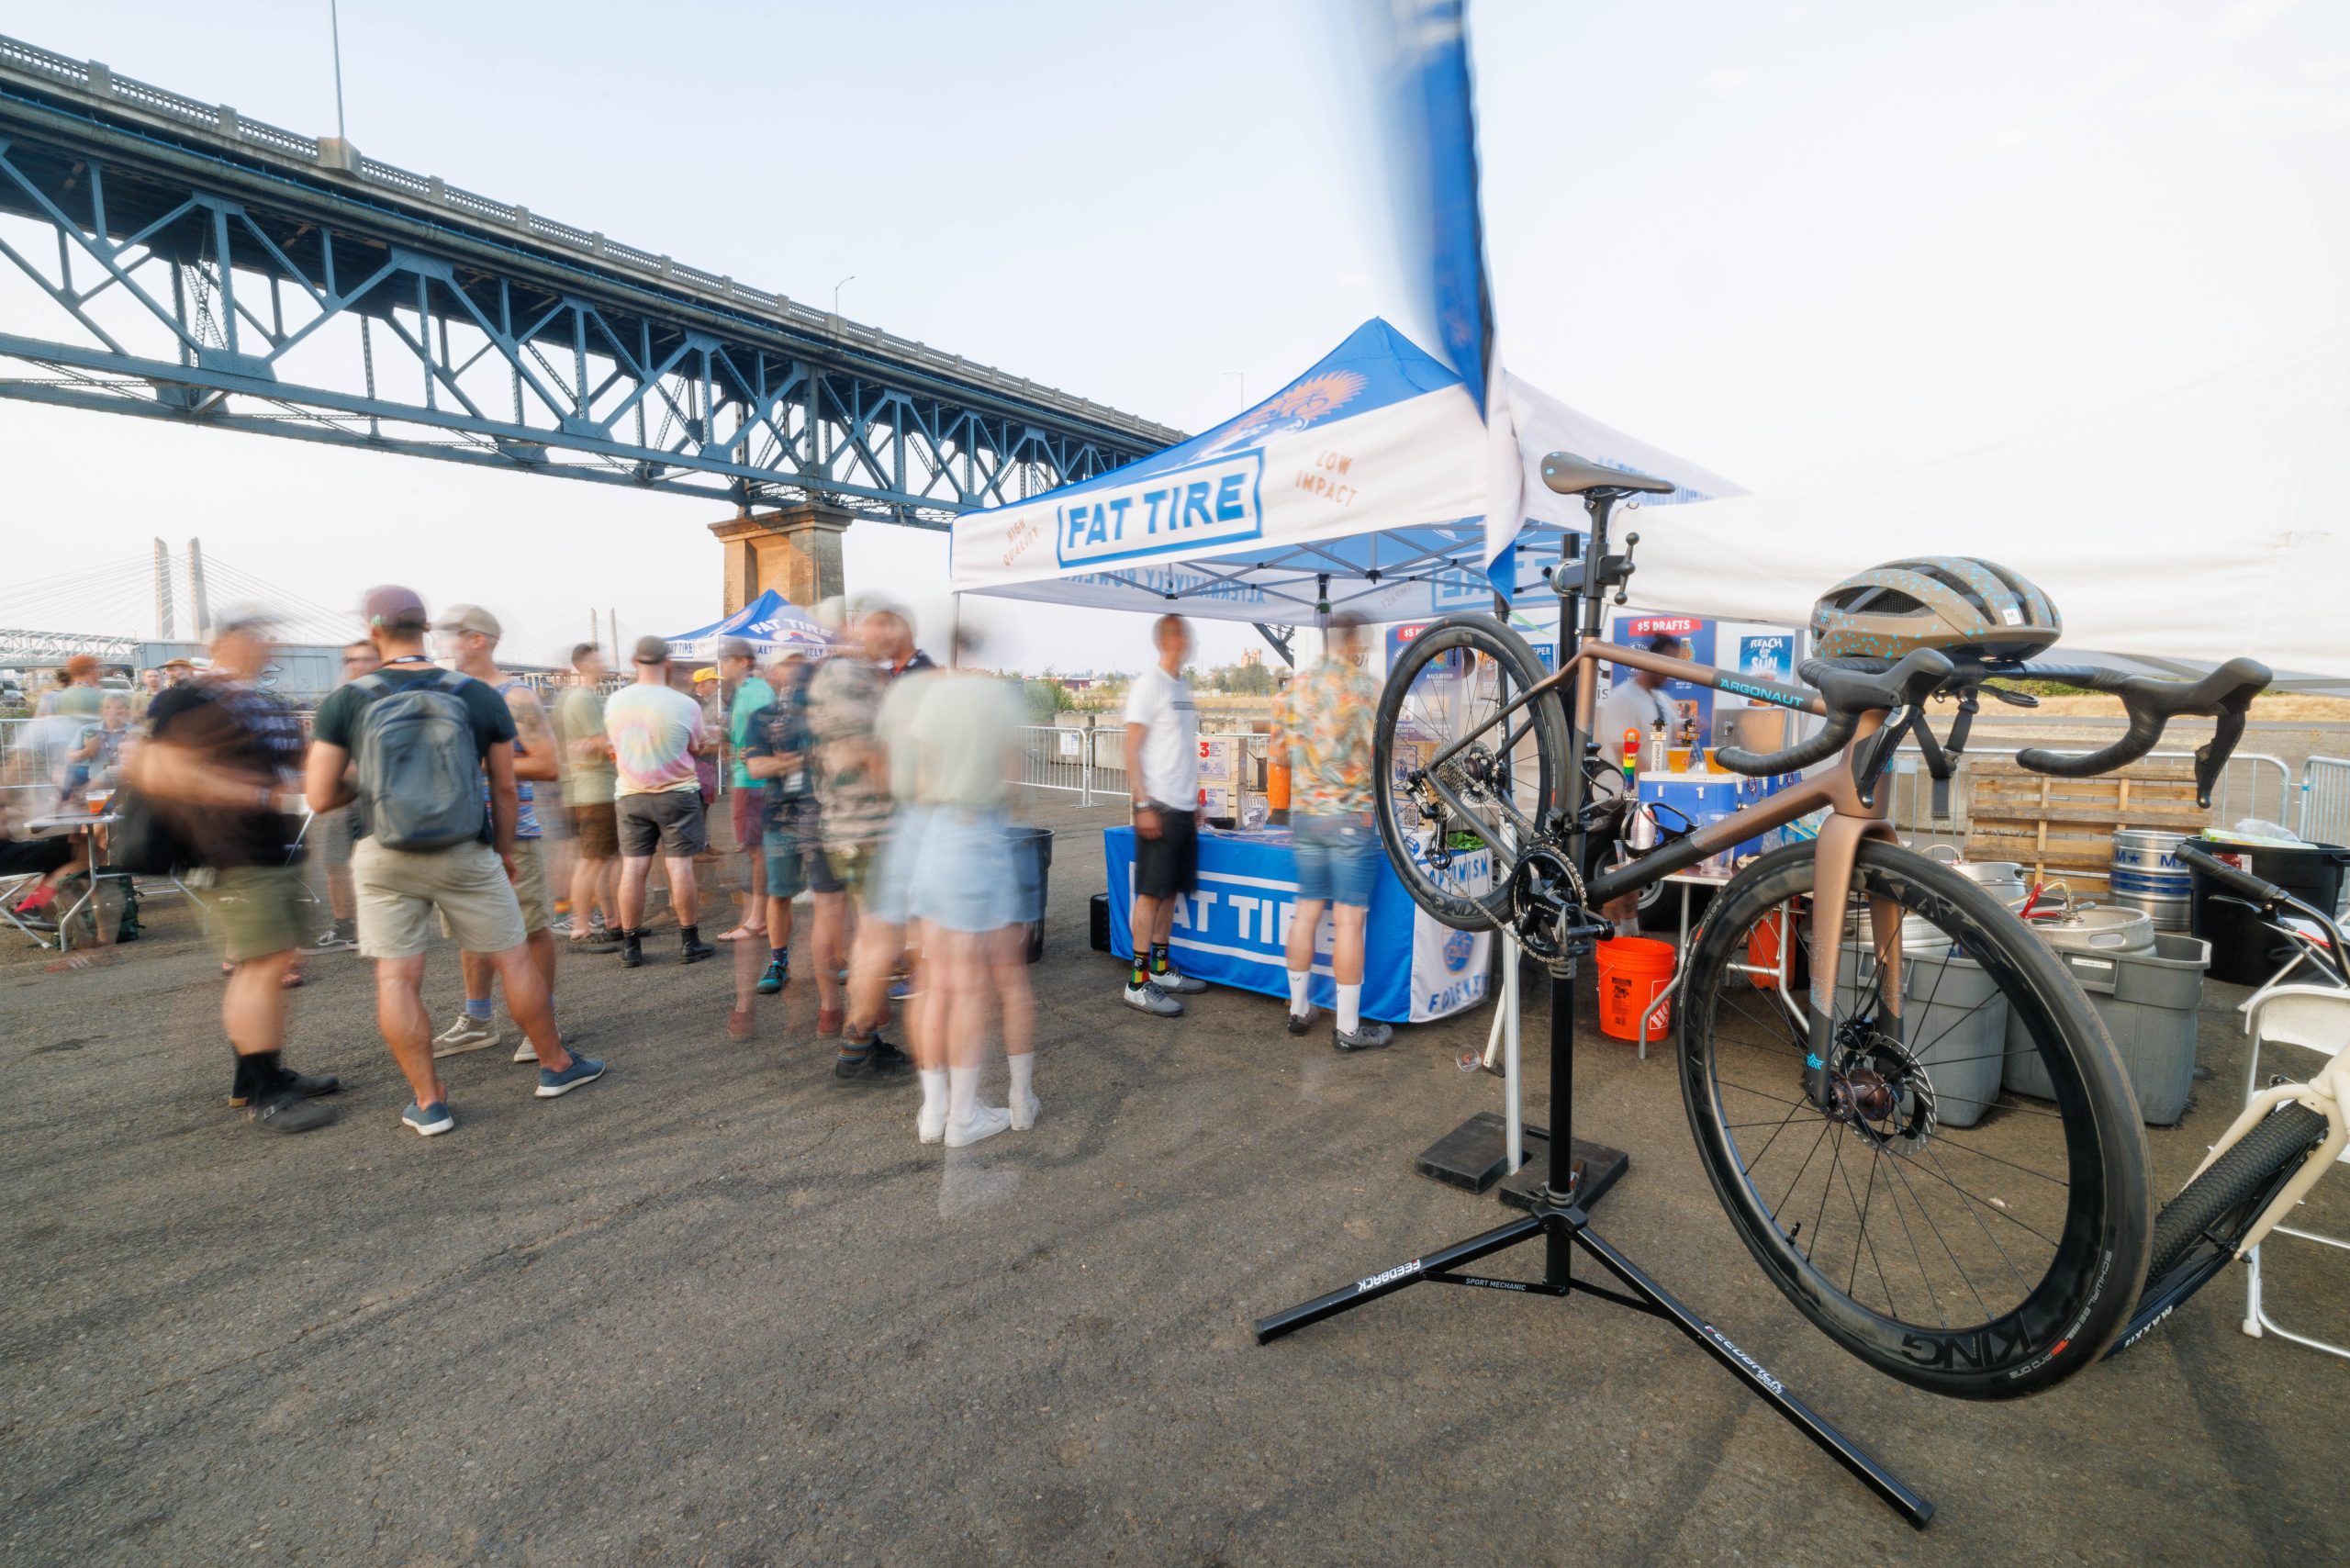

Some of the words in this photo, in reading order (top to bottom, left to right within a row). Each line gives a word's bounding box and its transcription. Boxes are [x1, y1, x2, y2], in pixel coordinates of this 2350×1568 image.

[1316, 450, 1353, 476] LOW
[1295, 469, 1359, 507] IMPACT
[1068, 497, 1133, 548] FAT
[1144, 472, 1248, 534] TIRE
[1006, 517, 1026, 543] HIGH
[1002, 525, 1040, 566] QUALITY
[748, 618, 780, 634] FAT
[784, 618, 834, 637] TIRE
[1404, 628, 1414, 637] $5
[1638, 622, 1650, 632] $5
[1653, 621, 1690, 632] DRAFTS
[1751, 638, 1782, 648] REACH
[1751, 657, 1777, 669] SUN
[1720, 678, 1803, 707] ARGONAUT
[1199, 742, 1210, 758] 3
[2115, 850, 2126, 863] M
[2160, 855, 2177, 867] M
[1429, 857, 1488, 888] OPTIMISM
[1358, 1259, 1421, 1293] FEEDBACK
[1465, 1277, 1488, 1286] SPORT
[1489, 1281, 1527, 1292] MECHANIC
[2078, 1249, 2112, 1324] SCHWALBE
[2123, 1305, 2173, 1349] MAXXIS
[1901, 1313, 2033, 1369] KING
[1755, 1372, 1783, 1394] SPORTS
